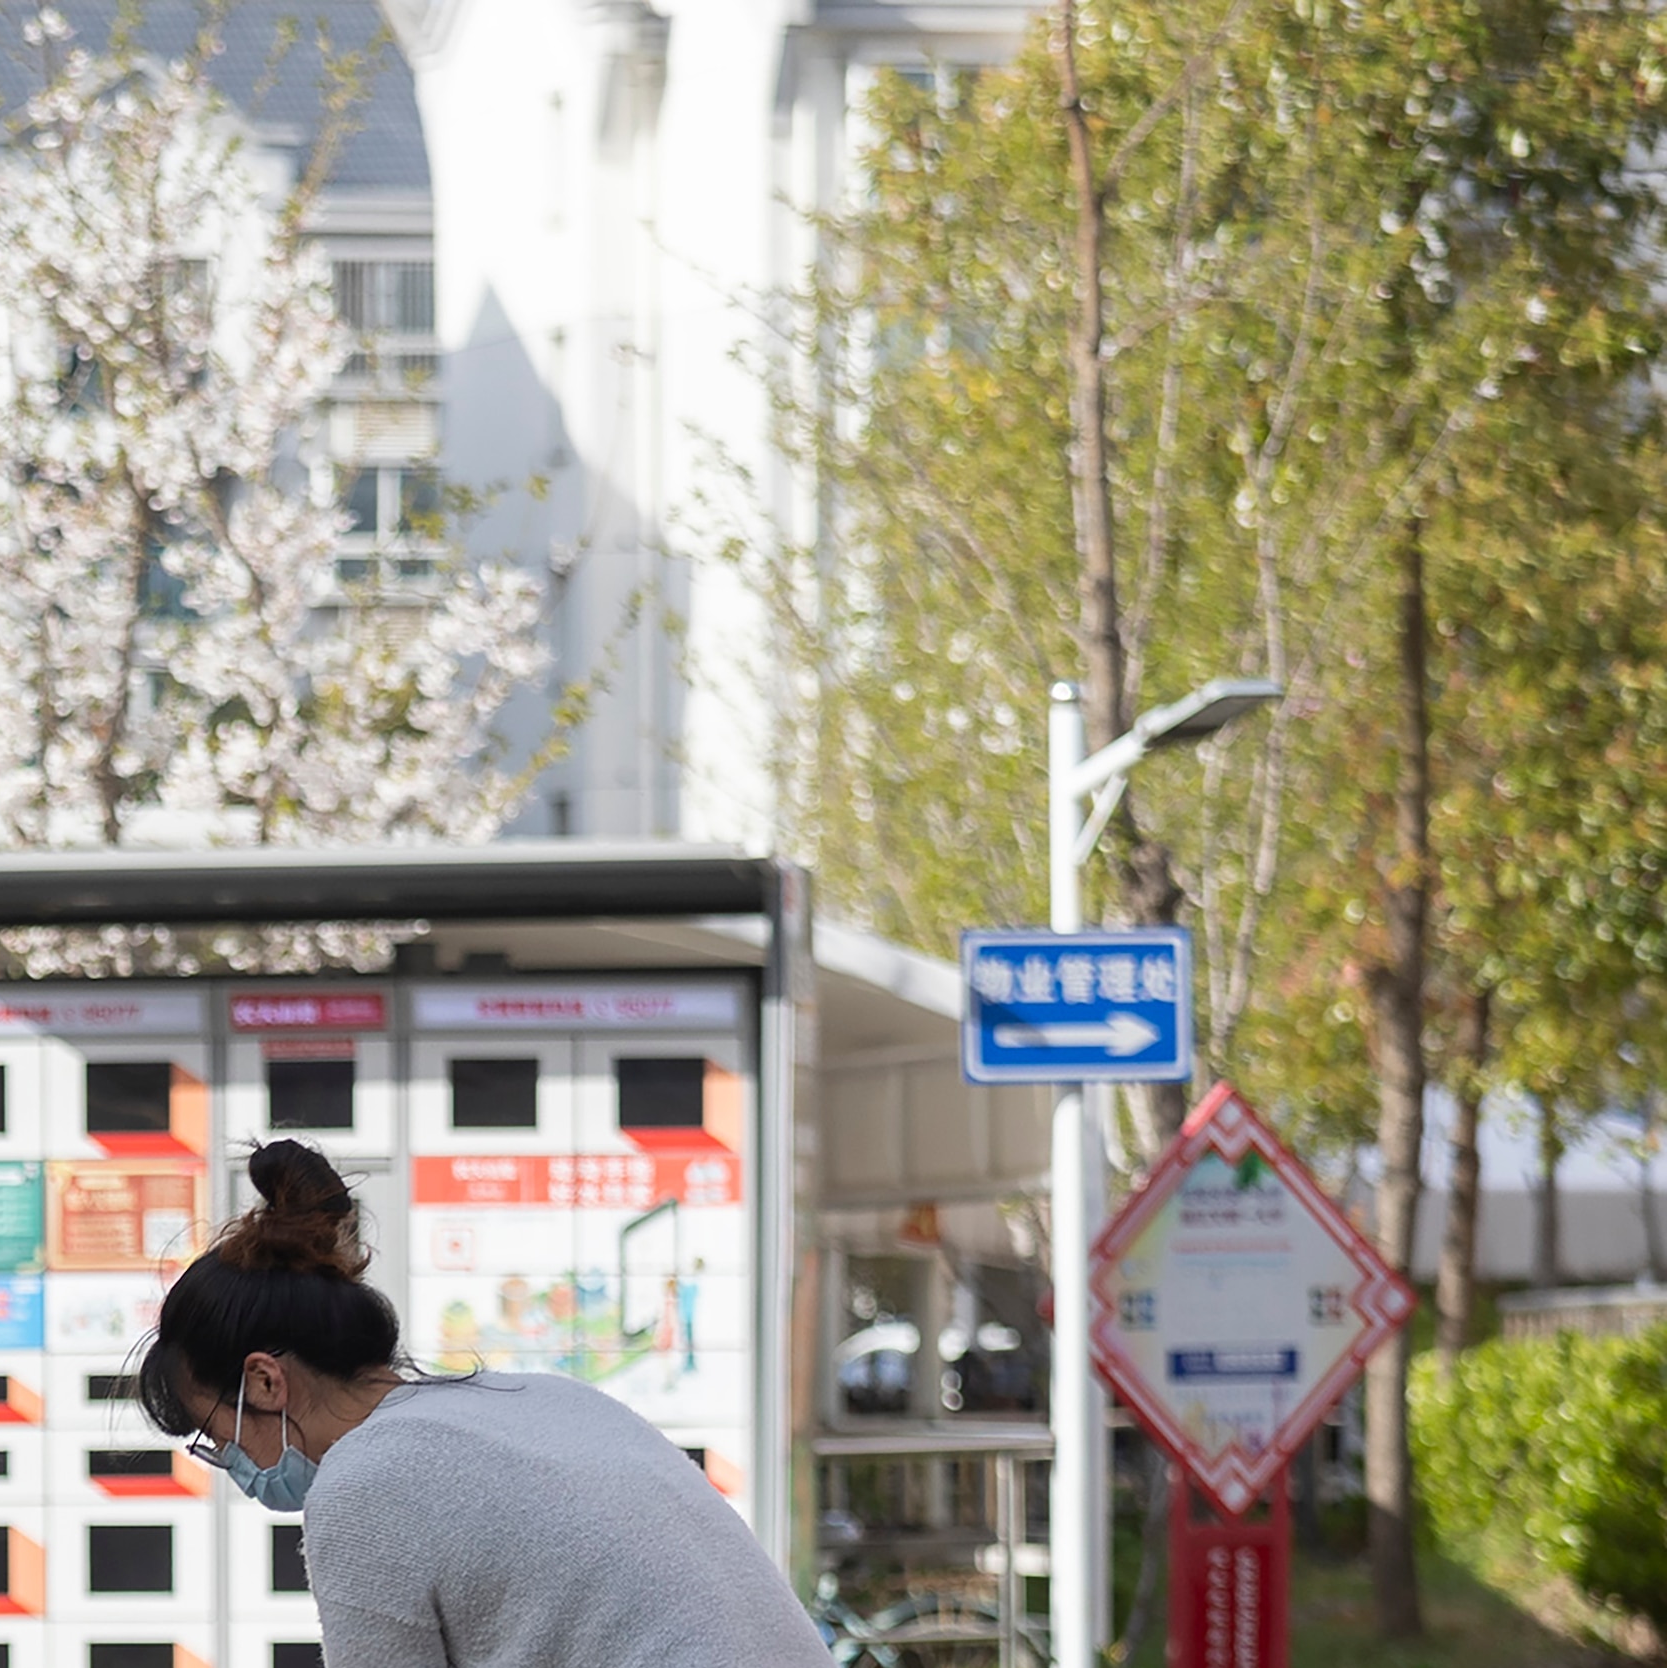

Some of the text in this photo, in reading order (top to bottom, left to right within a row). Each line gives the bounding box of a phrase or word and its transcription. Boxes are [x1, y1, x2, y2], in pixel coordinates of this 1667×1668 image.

[974, 954, 1179, 1004] 物业管理处
